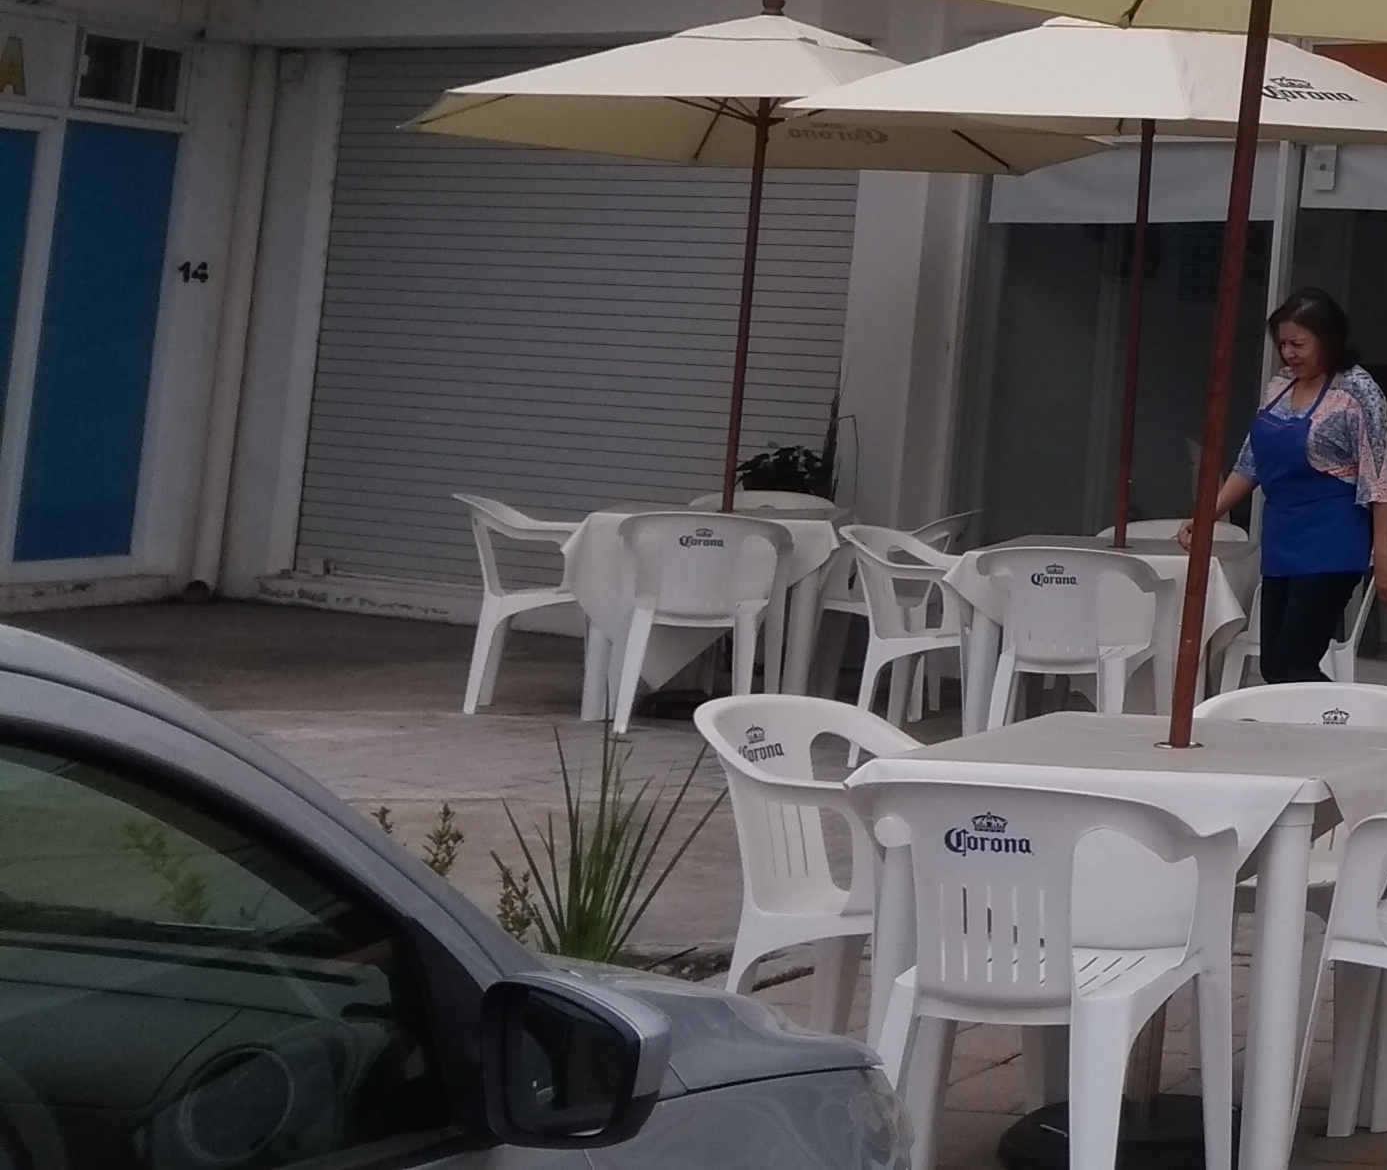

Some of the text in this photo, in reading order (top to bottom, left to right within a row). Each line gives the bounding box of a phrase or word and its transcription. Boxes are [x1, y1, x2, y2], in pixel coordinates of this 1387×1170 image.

[1262, 84, 1359, 103] Corona
[178, 261, 209, 284] 14
[680, 535, 724, 549] Corona
[1030, 572, 1078, 588] Corona
[944, 827, 1033, 857] Corona
